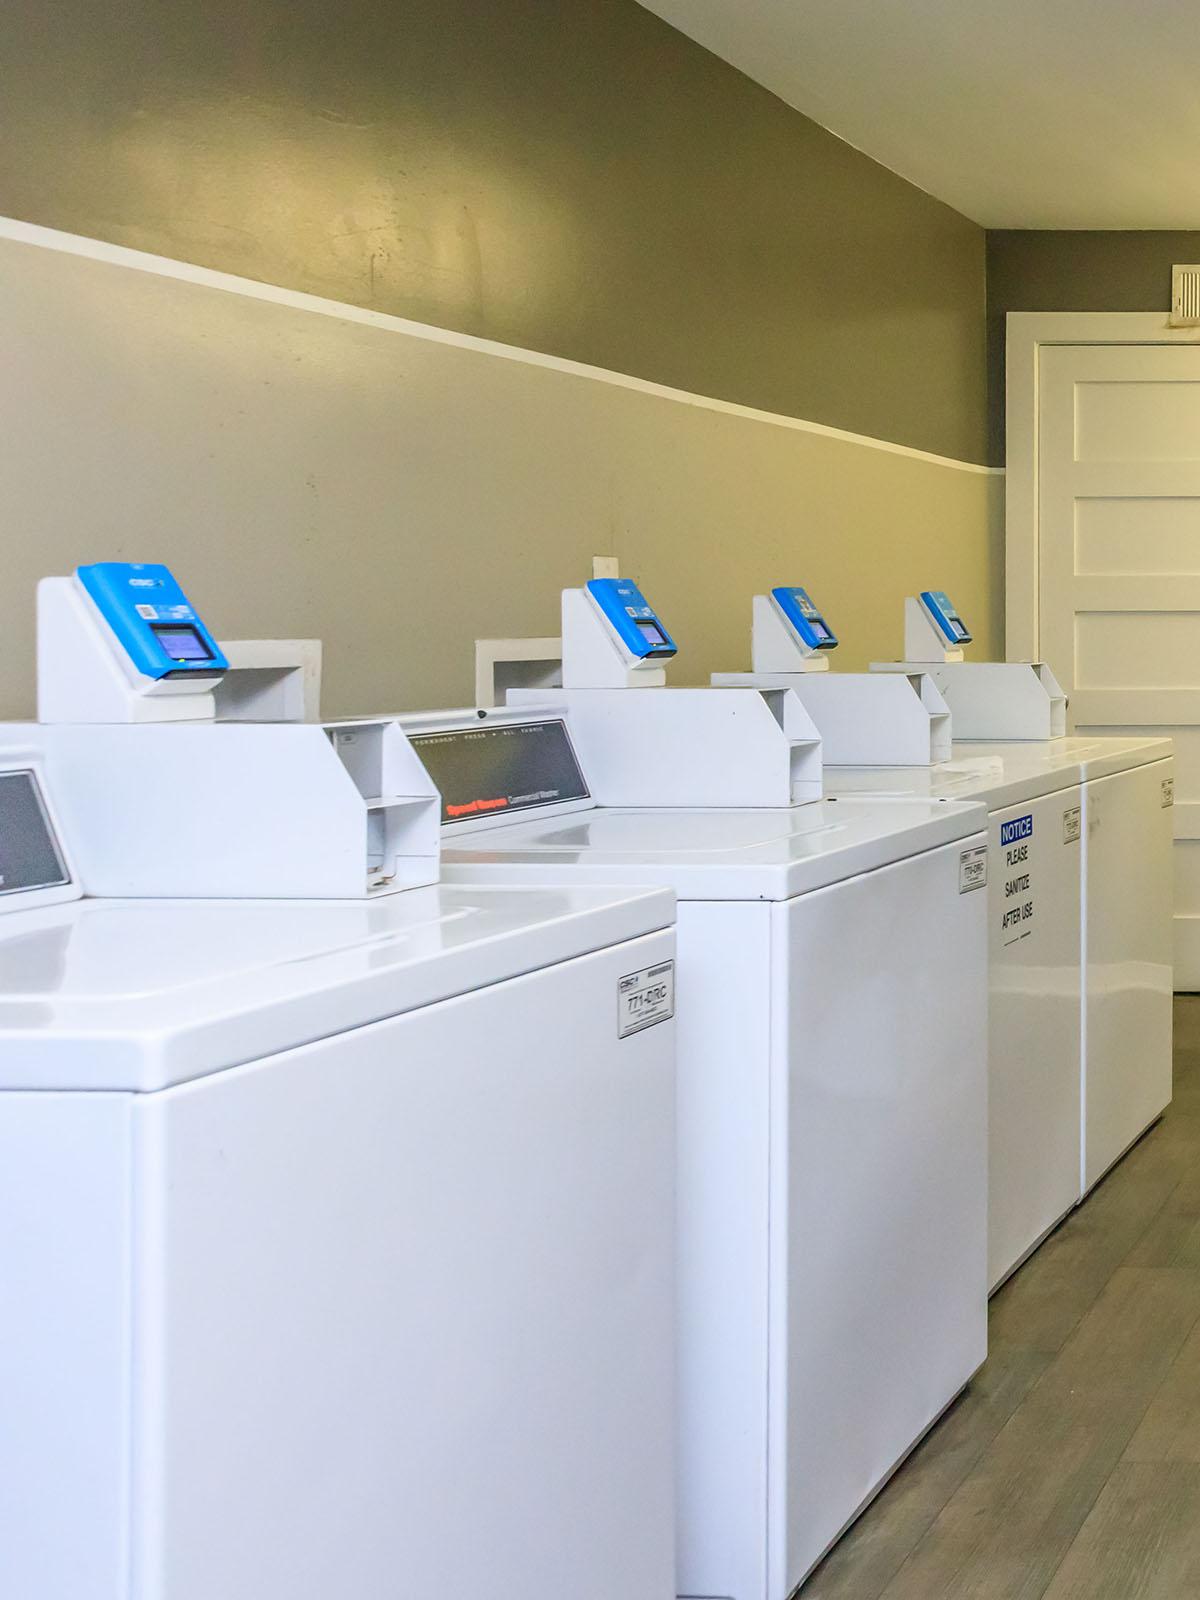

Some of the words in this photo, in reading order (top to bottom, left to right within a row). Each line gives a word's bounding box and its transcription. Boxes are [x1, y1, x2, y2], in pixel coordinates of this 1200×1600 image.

[1002, 816, 1032, 843] NOTICE
[1006, 845, 1028, 867] PLEASE
[1005, 873, 1030, 898] SANITIZE
[1002, 907, 1021, 930] AFTER
[1021, 901, 1033, 920] USE
[627, 985, 667, 1011] 771-DRC
